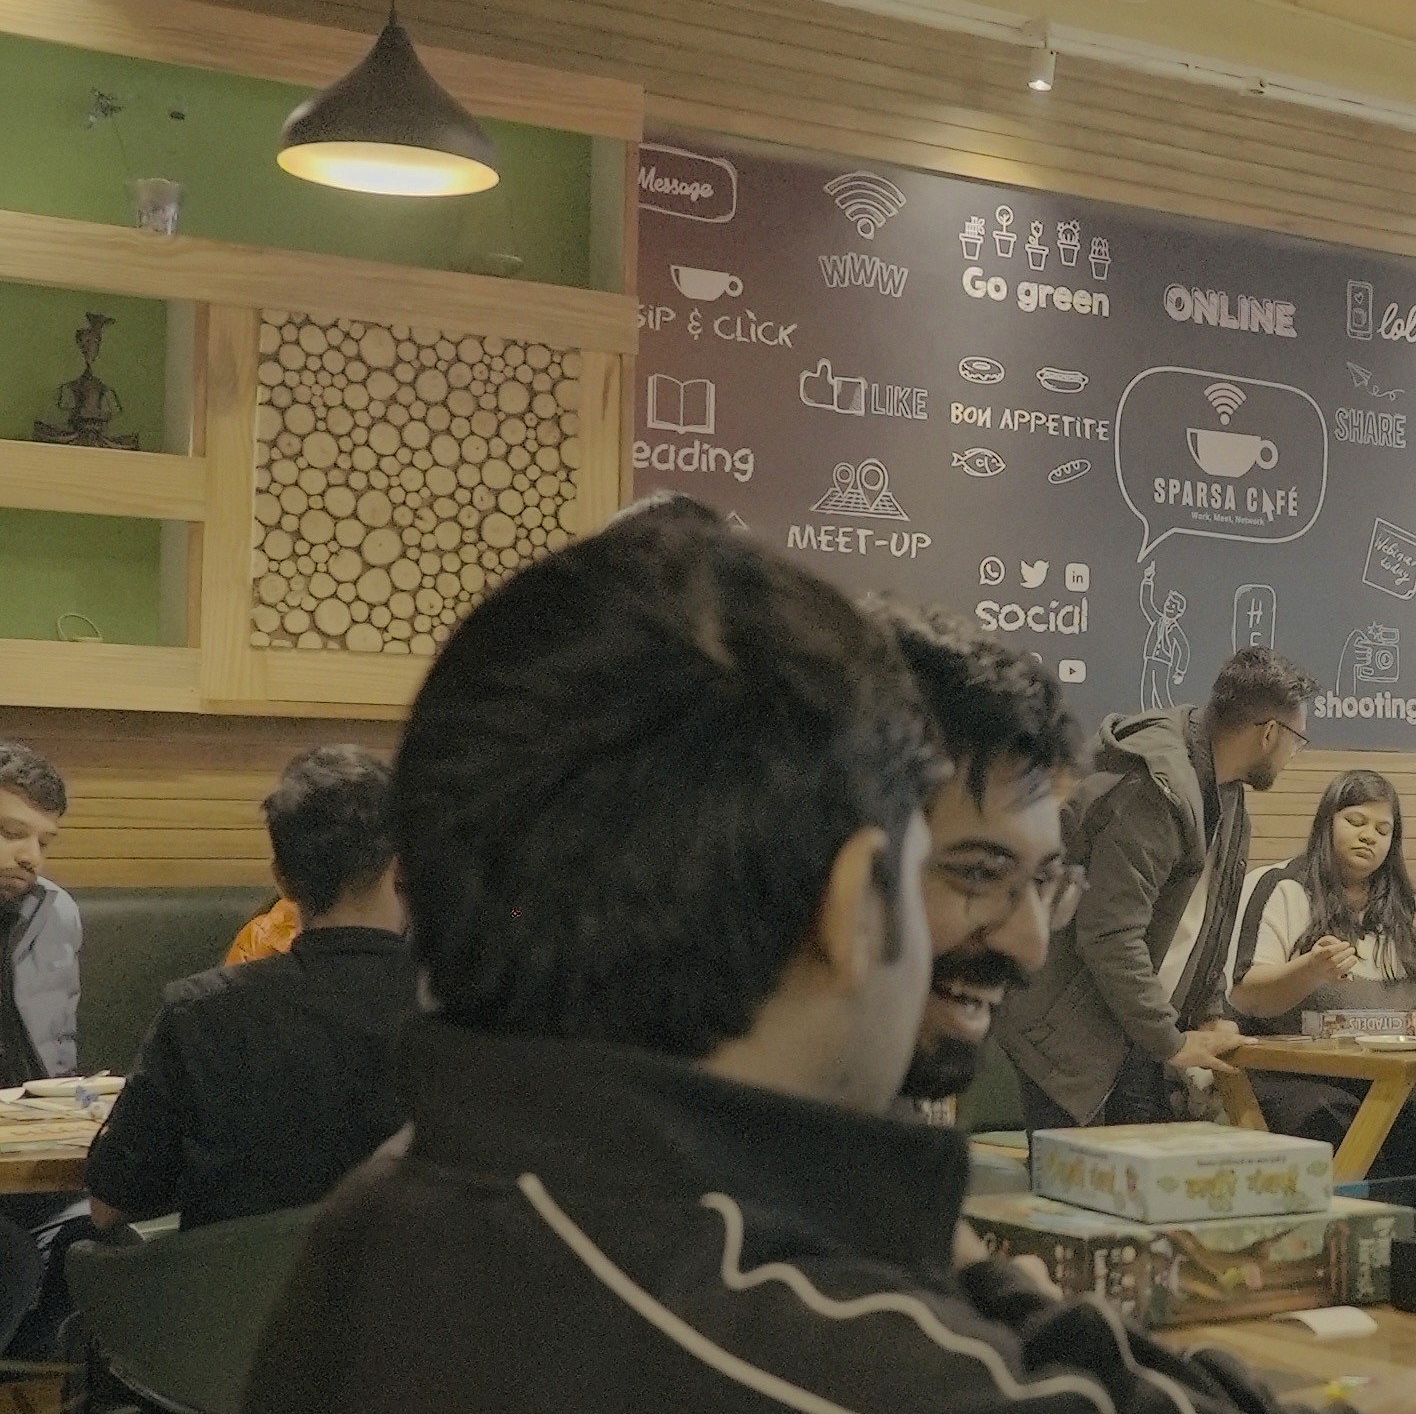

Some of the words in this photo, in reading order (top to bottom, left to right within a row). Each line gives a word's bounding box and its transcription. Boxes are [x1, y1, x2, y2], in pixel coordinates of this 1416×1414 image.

[638, 166, 715, 202] Message
[818, 251, 910, 298] WWW
[961, 266, 1008, 302] Go
[1016, 280, 1110, 318] green
[687, 306, 702, 340] &
[713, 308, 798, 349] CLICK
[1163, 282, 1298, 338] ONLINE
[870, 383, 930, 421] LIKE
[950, 401, 992, 429] BON
[1334, 406, 1408, 449] SHARE
[632, 438, 756, 483] eading
[1153, 476, 1237, 511] SPARSA
[786, 523, 933, 559] MEET-UP
[974, 596, 1089, 636] social
[1348, 1017, 1403, 1032] CITADELS
